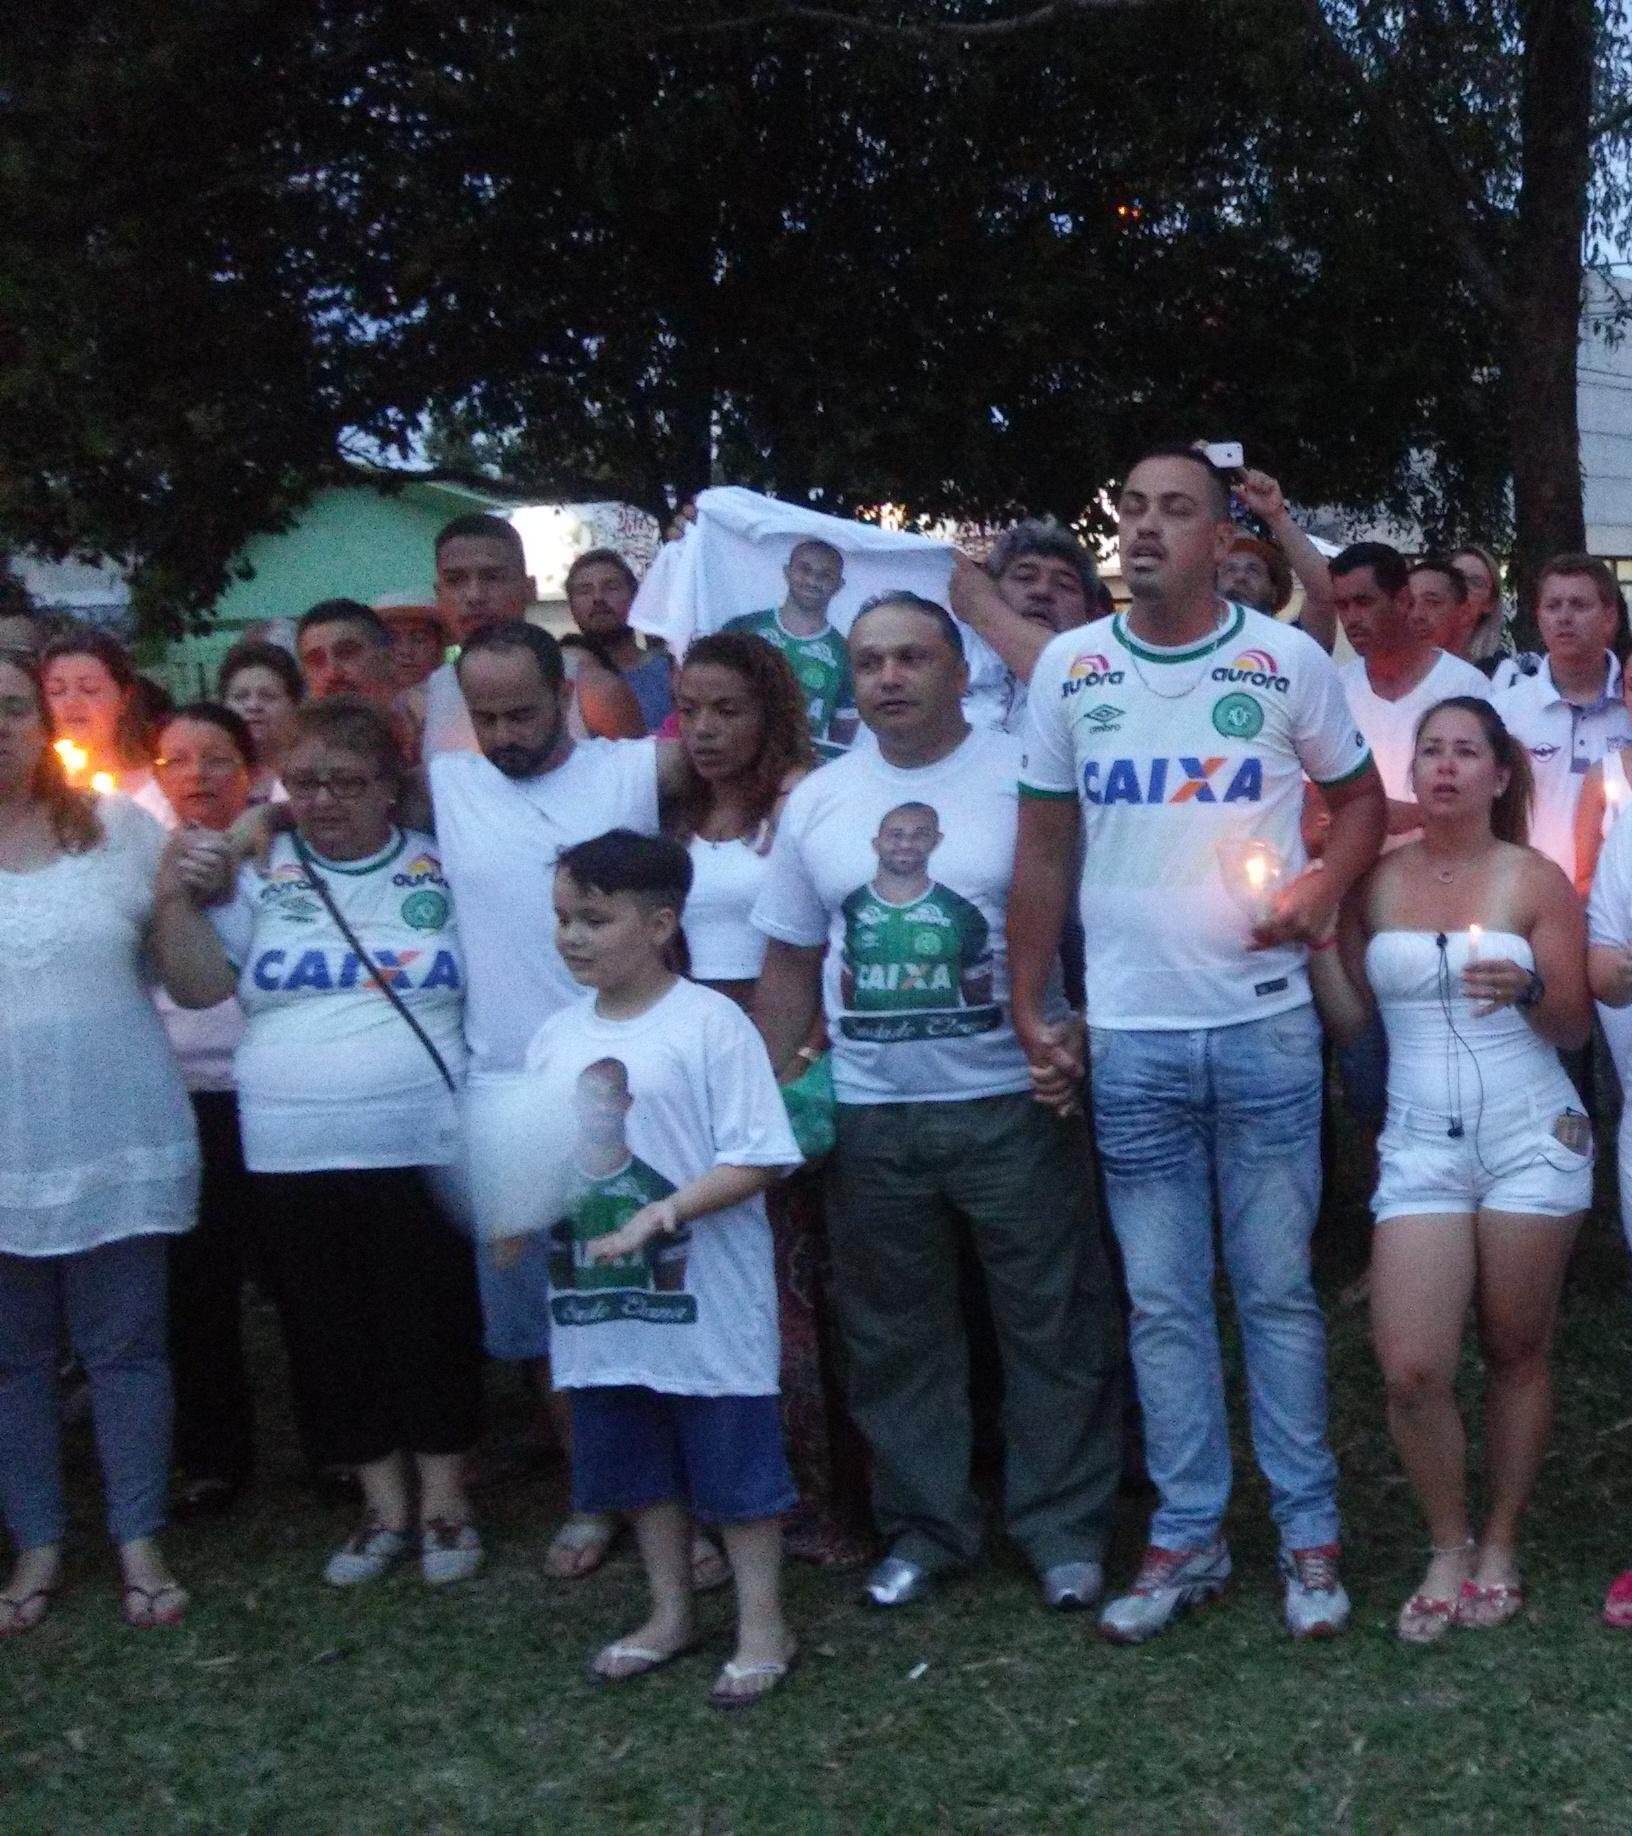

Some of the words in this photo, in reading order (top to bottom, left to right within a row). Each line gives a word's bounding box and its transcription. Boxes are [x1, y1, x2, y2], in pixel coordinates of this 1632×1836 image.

[1211, 666, 1290, 693] aurora
[1083, 756, 1263, 805] CAIXA
[254, 949, 460, 991] CAIXA
